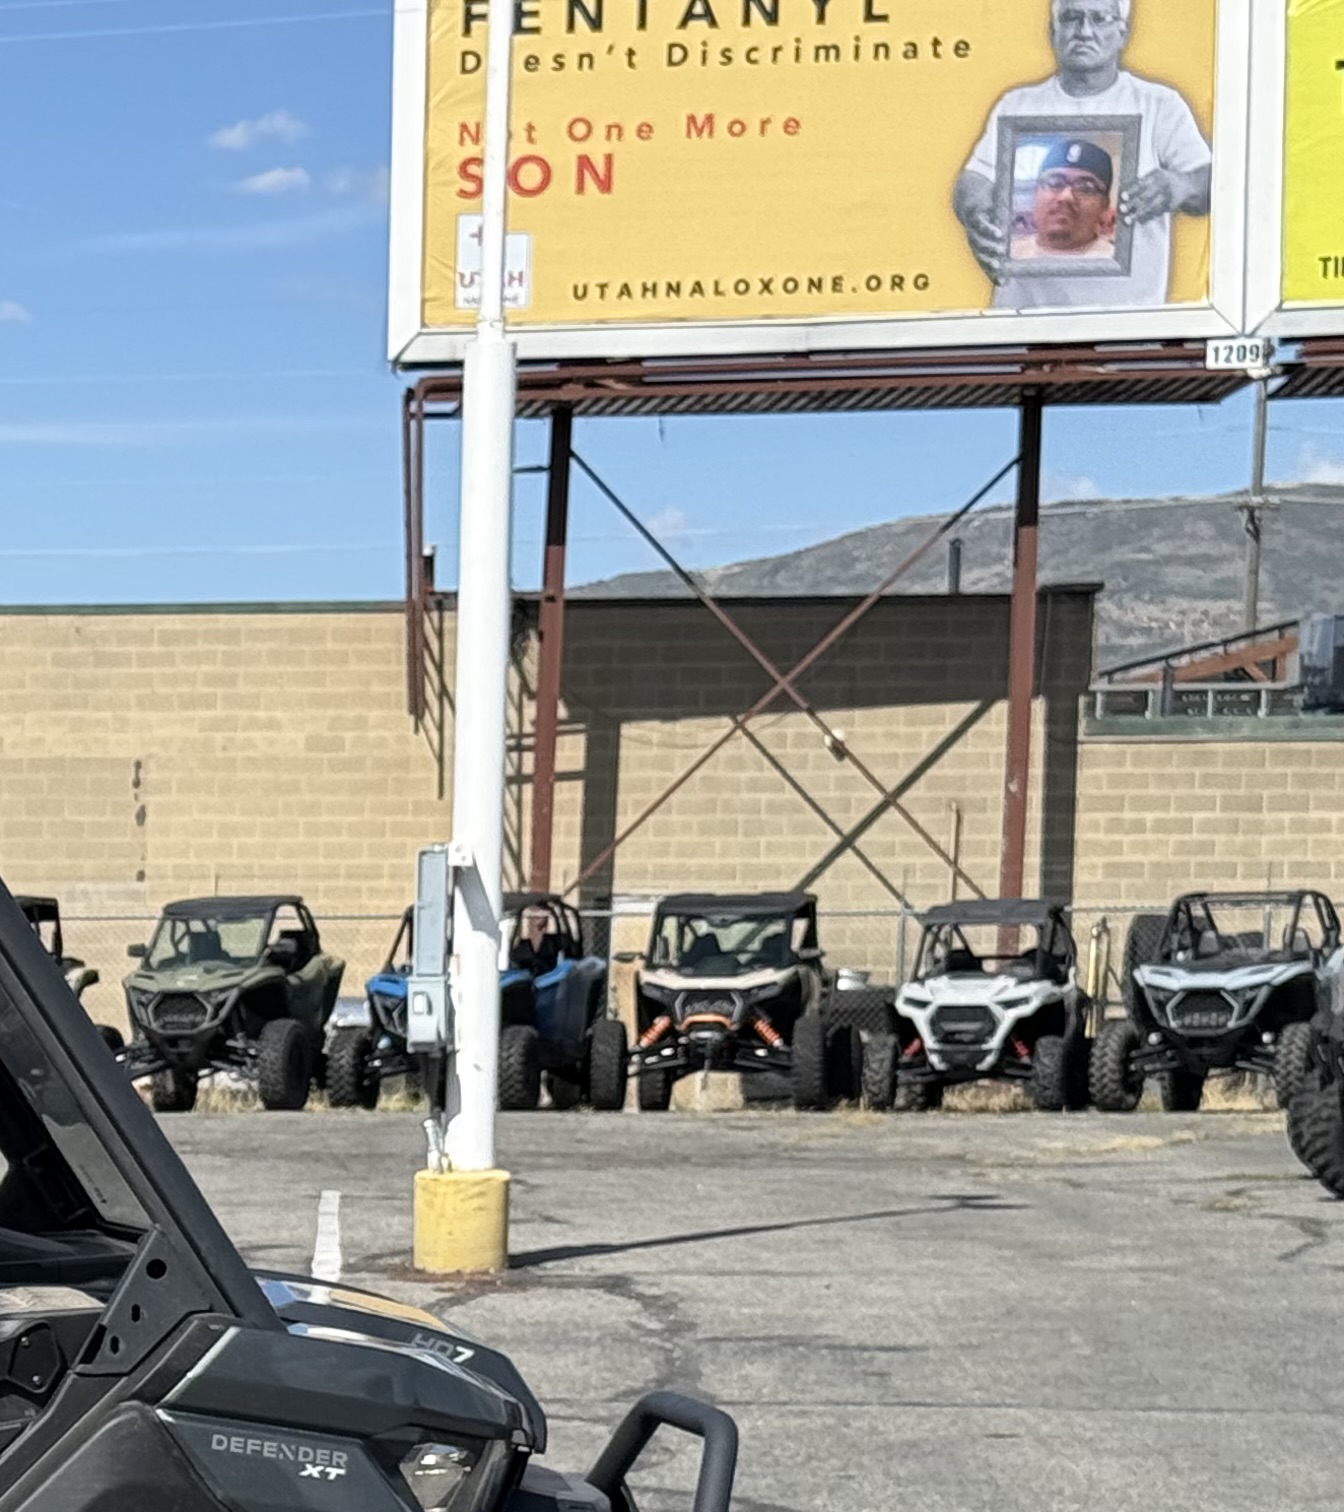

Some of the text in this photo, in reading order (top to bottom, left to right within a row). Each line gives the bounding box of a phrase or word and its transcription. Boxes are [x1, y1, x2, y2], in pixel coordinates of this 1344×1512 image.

[460, 35, 973, 75] Desn't Discriminate
[458, 113, 802, 147] Nt One More
[456, 153, 614, 200] SON
[573, 274, 932, 301] UTAHNALOXONE.ORG
[1213, 344, 1260, 365] 1209
[212, 1434, 348, 1468] DEFENDER
[298, 1463, 346, 1480] XT
